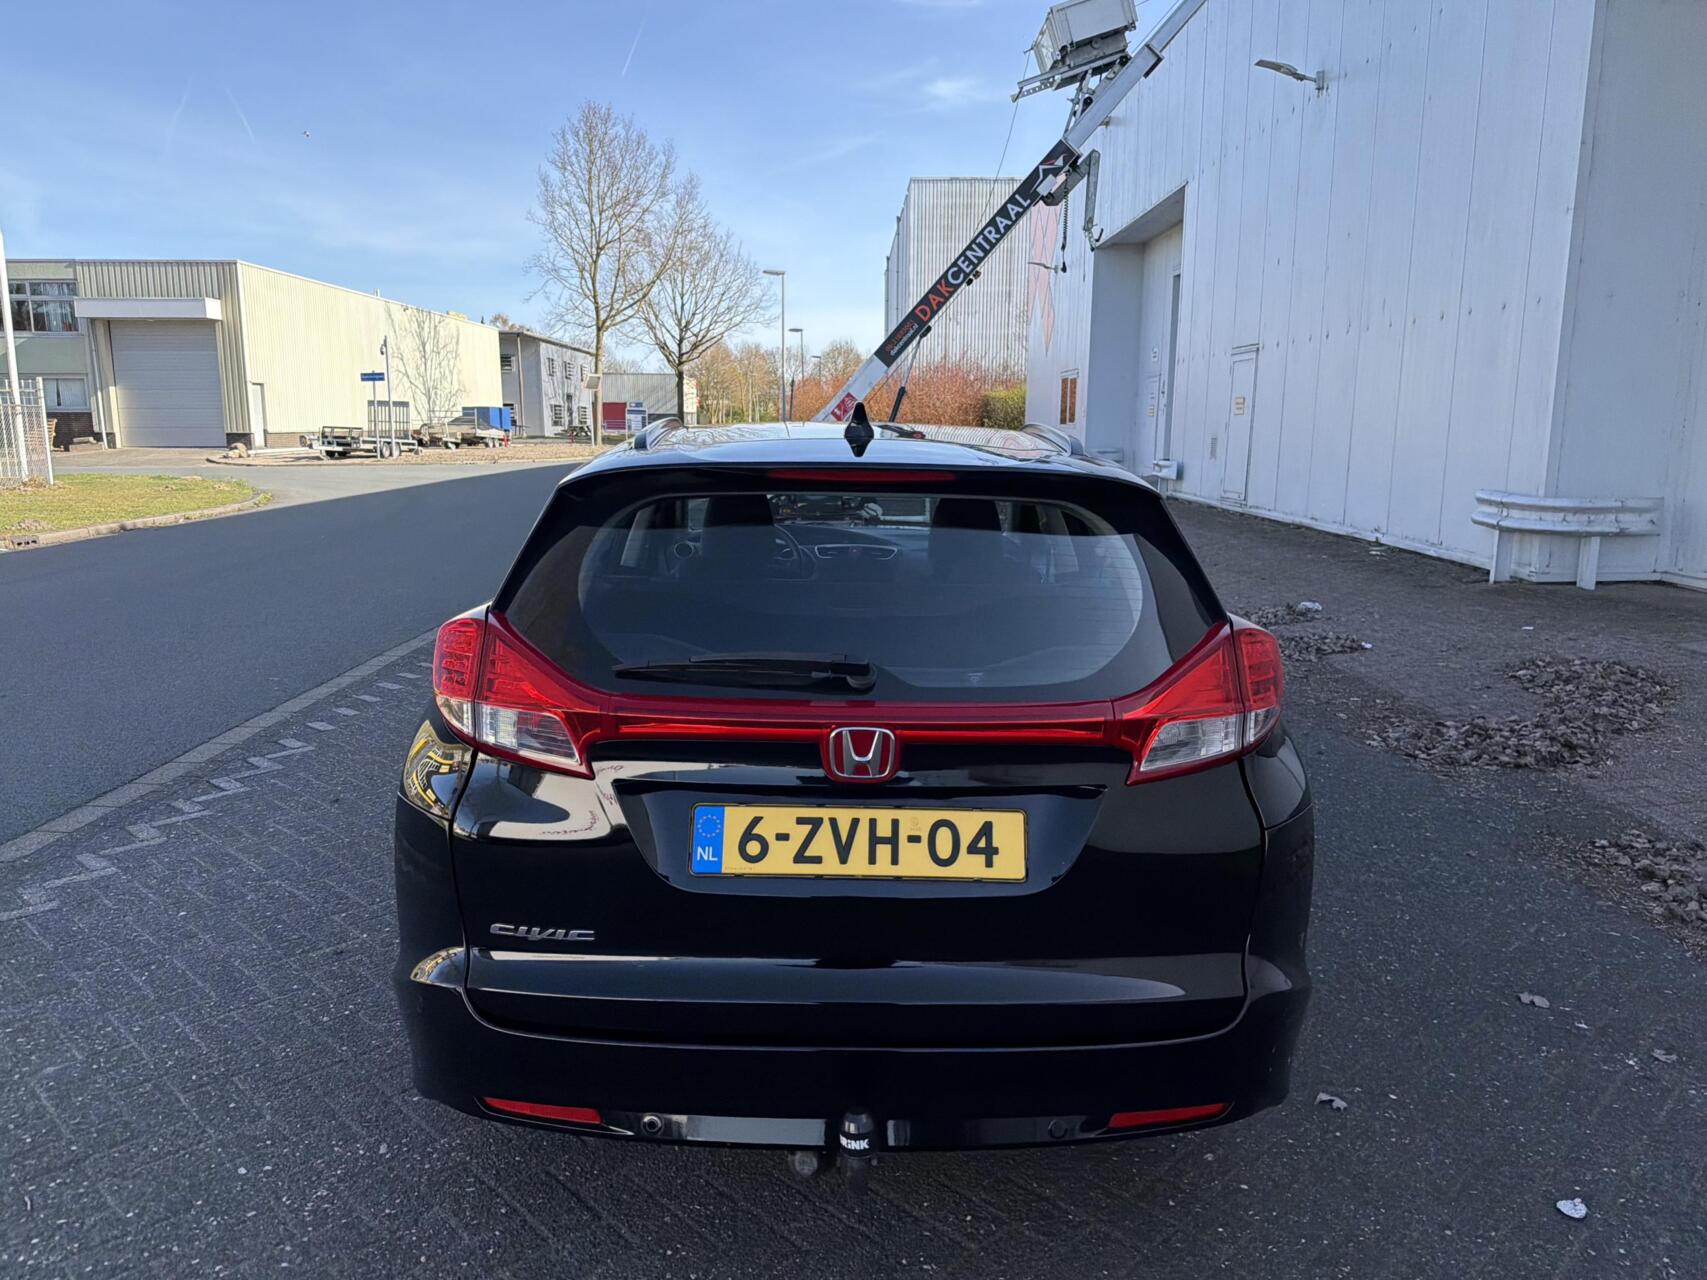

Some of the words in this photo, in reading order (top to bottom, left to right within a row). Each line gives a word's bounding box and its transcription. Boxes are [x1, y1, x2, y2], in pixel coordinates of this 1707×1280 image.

[915, 194, 1031, 321] DAKCENTRAAL
[697, 846, 718, 861] NL
[738, 816, 999, 869] 6-ZVH-04
[490, 923, 595, 941] CIVIC
